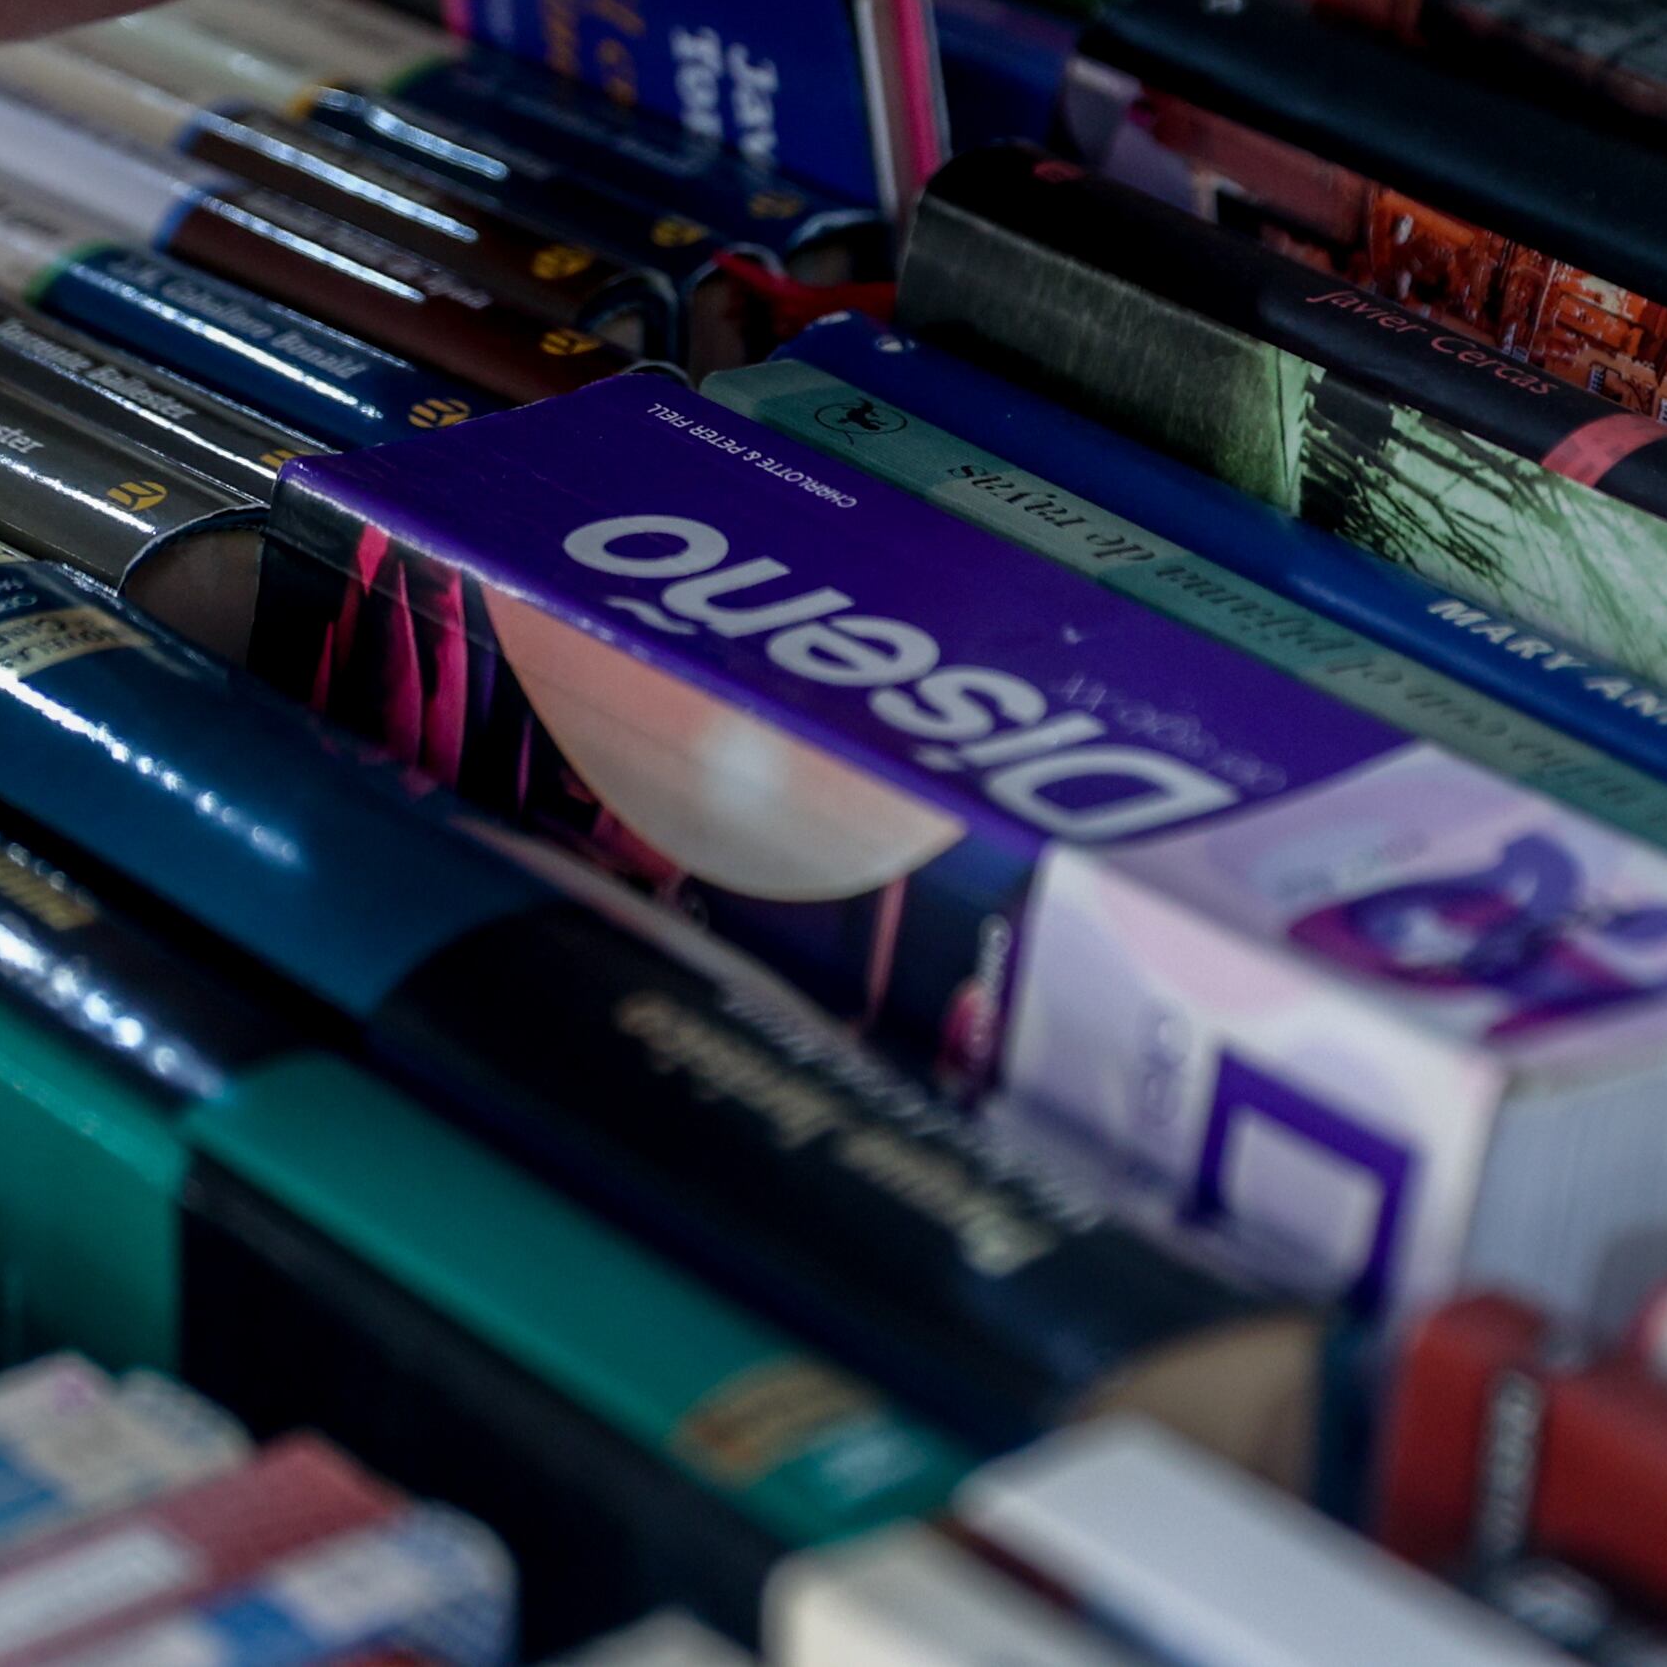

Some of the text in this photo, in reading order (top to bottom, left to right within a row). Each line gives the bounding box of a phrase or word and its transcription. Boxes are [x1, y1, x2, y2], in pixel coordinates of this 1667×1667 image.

[276, 324, 368, 381] Bonald
[1306, 284, 1562, 395] Javier Cercas
[86, 363, 197, 421] Ballester
[646, 403, 699, 436] FIELL
[691, 420, 745, 461] PETER
[762, 450, 859, 510] CHARLOTTE
[948, 463, 1089, 529] rayas
[1085, 529, 1156, 567] de
[1154, 558, 1356, 659] pijama
[1428, 598, 1590, 672] MARY
[563, 513, 1241, 842] Diseño
[1328, 650, 1403, 687] el
[1405, 680, 1502, 741] con
